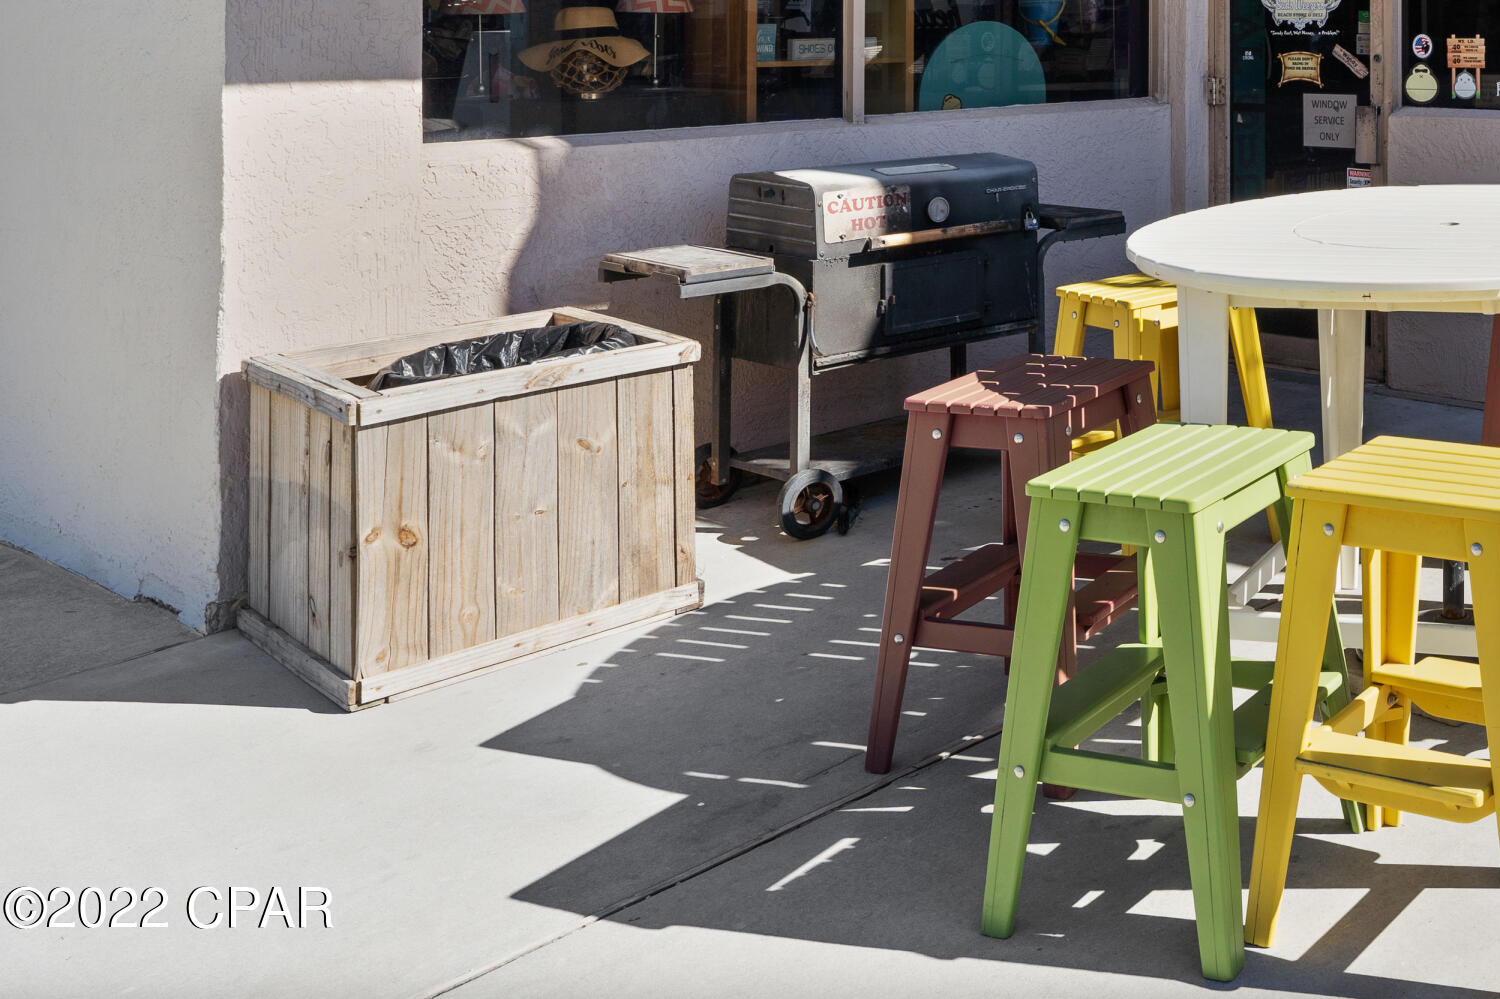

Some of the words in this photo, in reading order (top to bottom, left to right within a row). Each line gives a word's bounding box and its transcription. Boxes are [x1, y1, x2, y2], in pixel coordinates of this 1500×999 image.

[1311, 100, 1348, 109] WINDOW
[1313, 115, 1345, 126] SERVICE
[1319, 132, 1340, 141] ONLY
[827, 191, 908, 215] CAUTION
[851, 214, 888, 232] HOT
